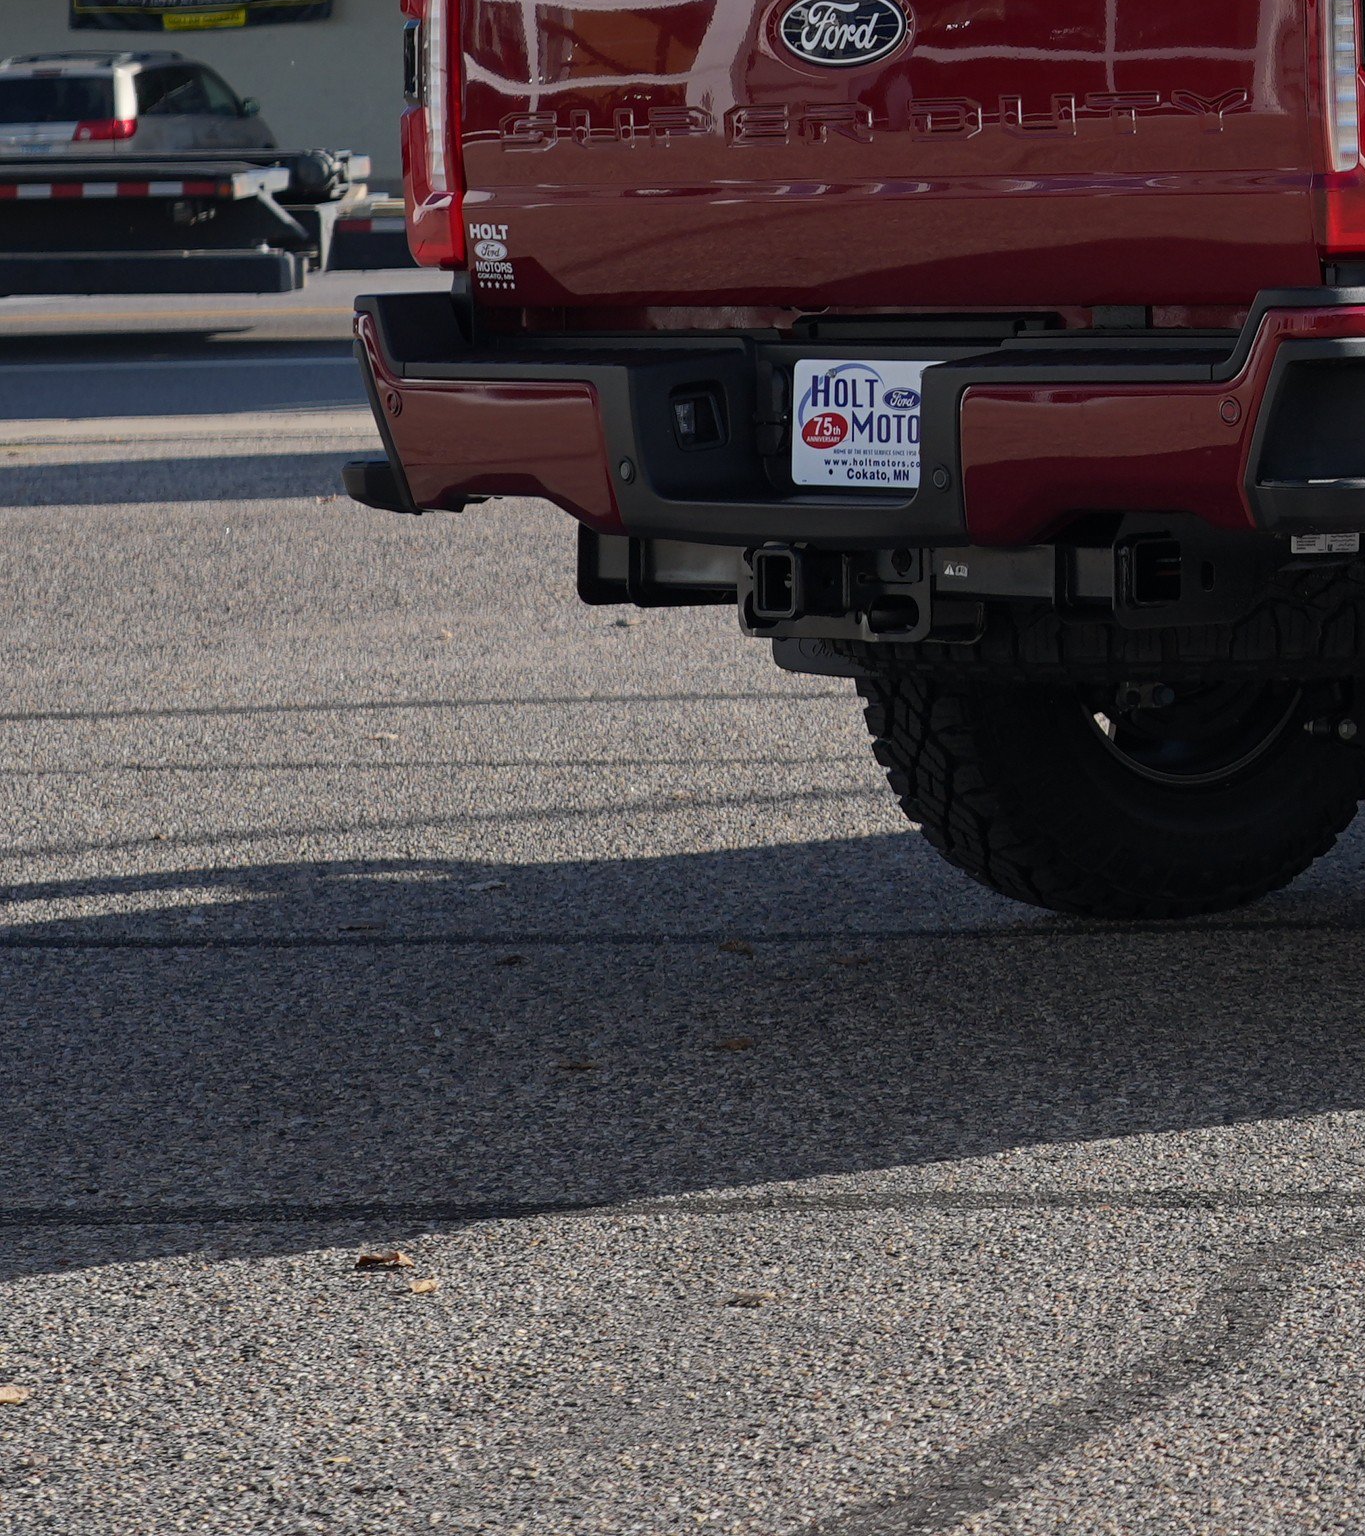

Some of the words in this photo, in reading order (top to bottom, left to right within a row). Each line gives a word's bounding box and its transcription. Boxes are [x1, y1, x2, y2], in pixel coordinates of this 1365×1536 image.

[801, 1, 880, 50] Ford
[502, 100, 873, 152] SUPER
[907, 88, 1248, 141] DUTY
[469, 223, 508, 240] HOLT
[481, 244, 500, 257] Ford
[475, 261, 513, 273] MOTORS
[811, 374, 879, 408] HOLT
[889, 391, 915, 407] Ford
[813, 416, 841, 436] 75th
[806, 435, 841, 443] ANNIVERSARY
[824, 458, 921, 468] www.holtmotors.co
[846, 469, 891, 483] Cokato,
[893, 470, 910, 481] MN
